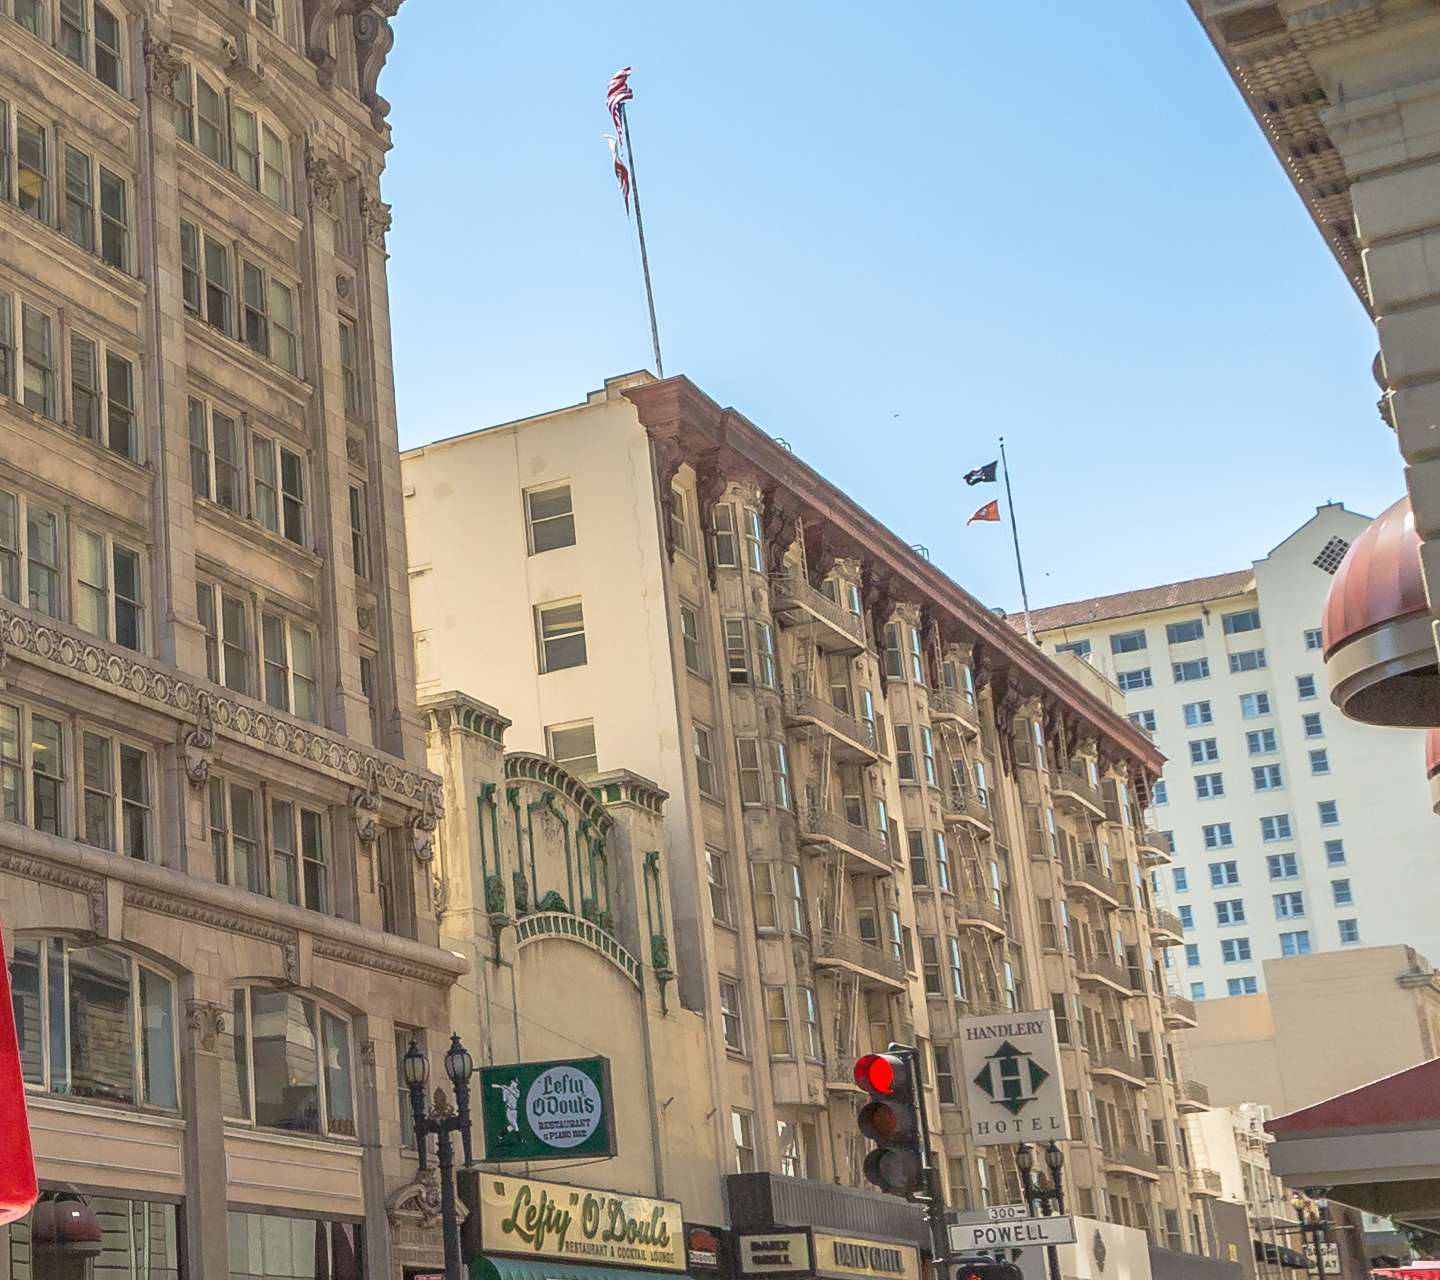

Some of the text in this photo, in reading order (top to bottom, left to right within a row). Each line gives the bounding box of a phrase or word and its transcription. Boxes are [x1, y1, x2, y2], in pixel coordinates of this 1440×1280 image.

[967, 1020, 1045, 1041] HANDLERY
[538, 1119, 591, 1131] RESTAURANT
[977, 1116, 1060, 1135] HOTEL
[581, 1192, 671, 1249] O'Doul's
[990, 1208, 1016, 1220] 300
[973, 1224, 1049, 1245] POWELL
[565, 1241, 608, 1258] RESTAURANT
[618, 1246, 648, 1262] COCKTAIL
[650, 1251, 675, 1265] LOUNGE
[750, 1240, 791, 1252] DAILY
[751, 1254, 792, 1265] GRILL
[832, 1241, 905, 1272] DAILY GRILL
